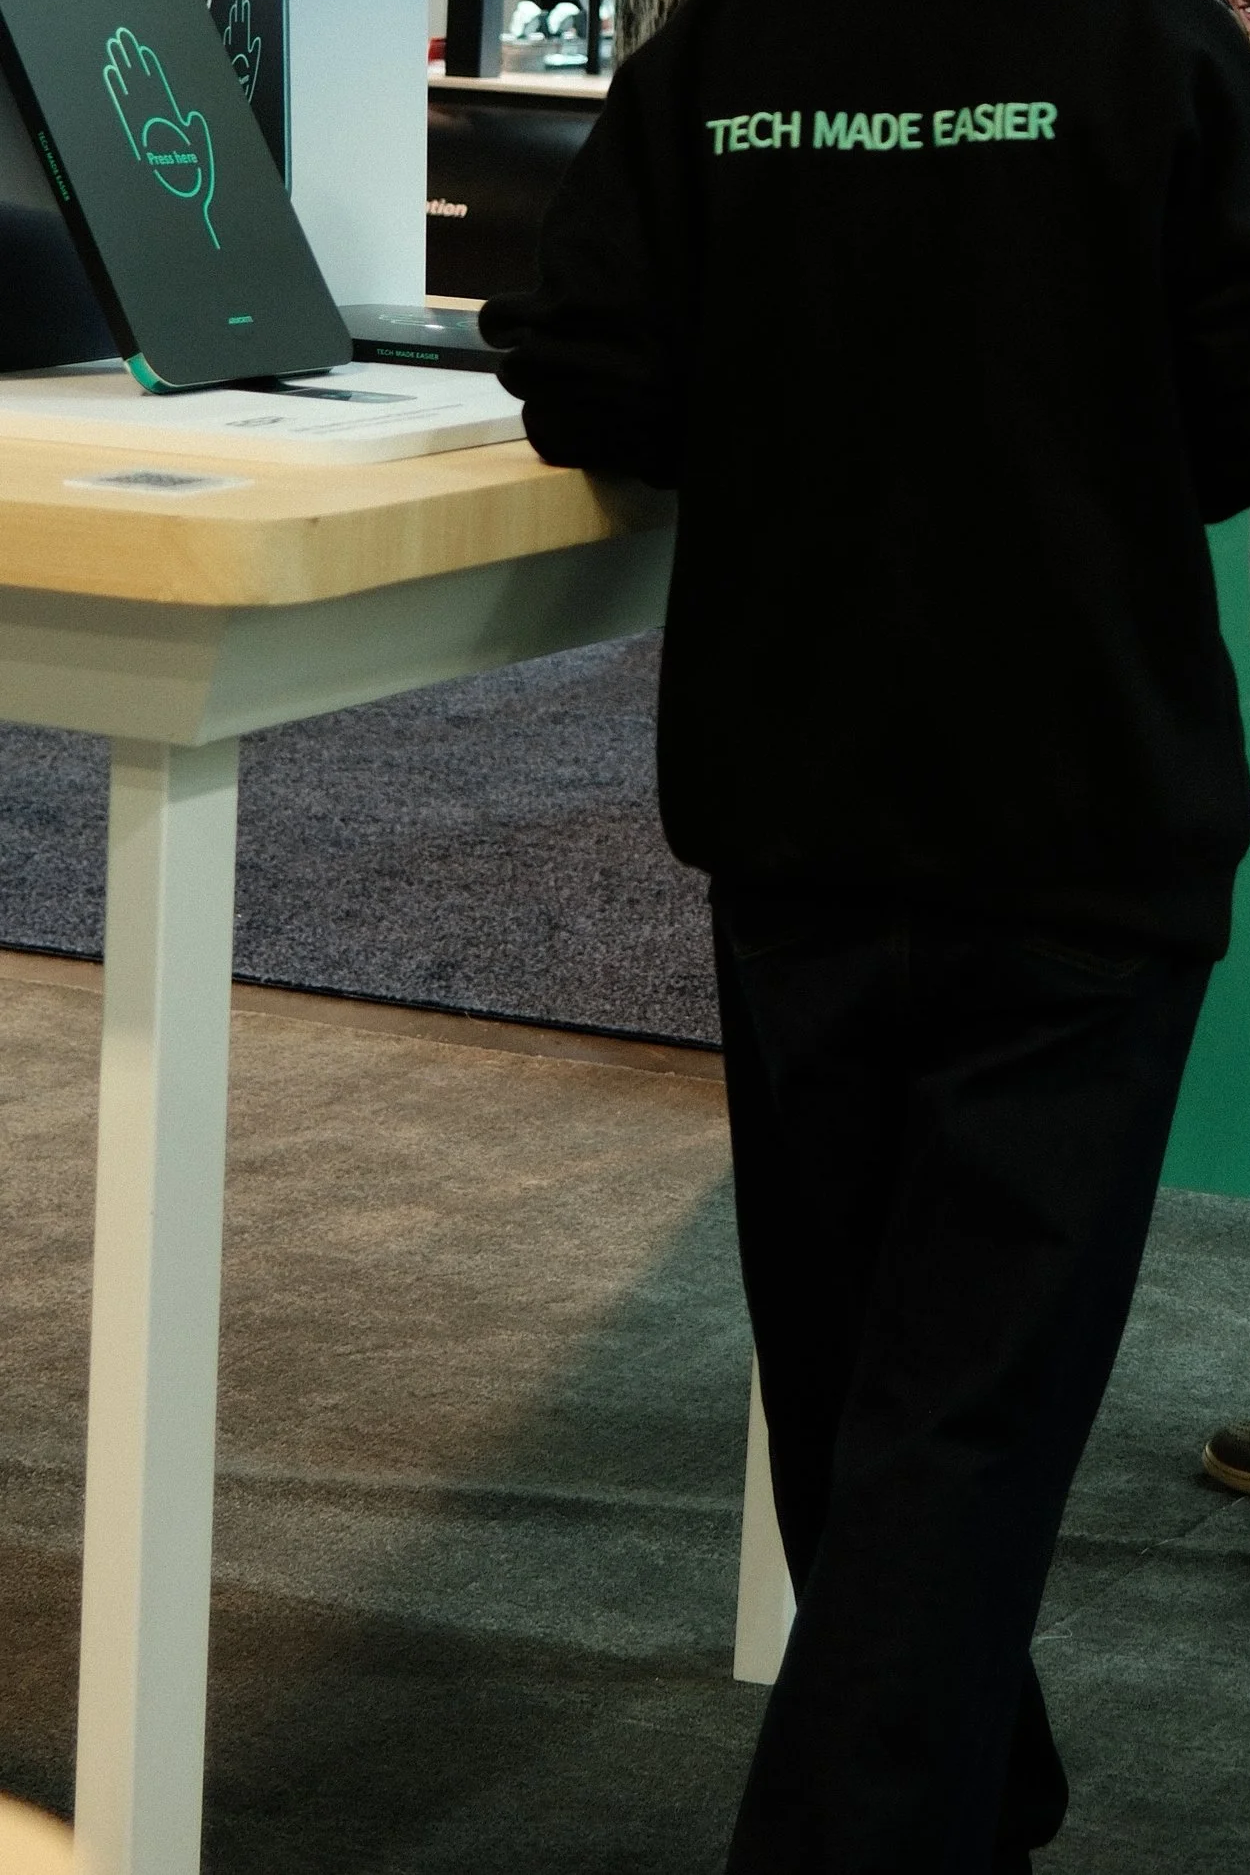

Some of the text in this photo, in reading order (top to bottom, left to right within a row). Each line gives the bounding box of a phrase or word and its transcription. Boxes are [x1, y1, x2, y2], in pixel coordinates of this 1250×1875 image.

[706, 102, 1058, 155] TECH MADE EASIER
[147, 151, 197, 165] Press here
